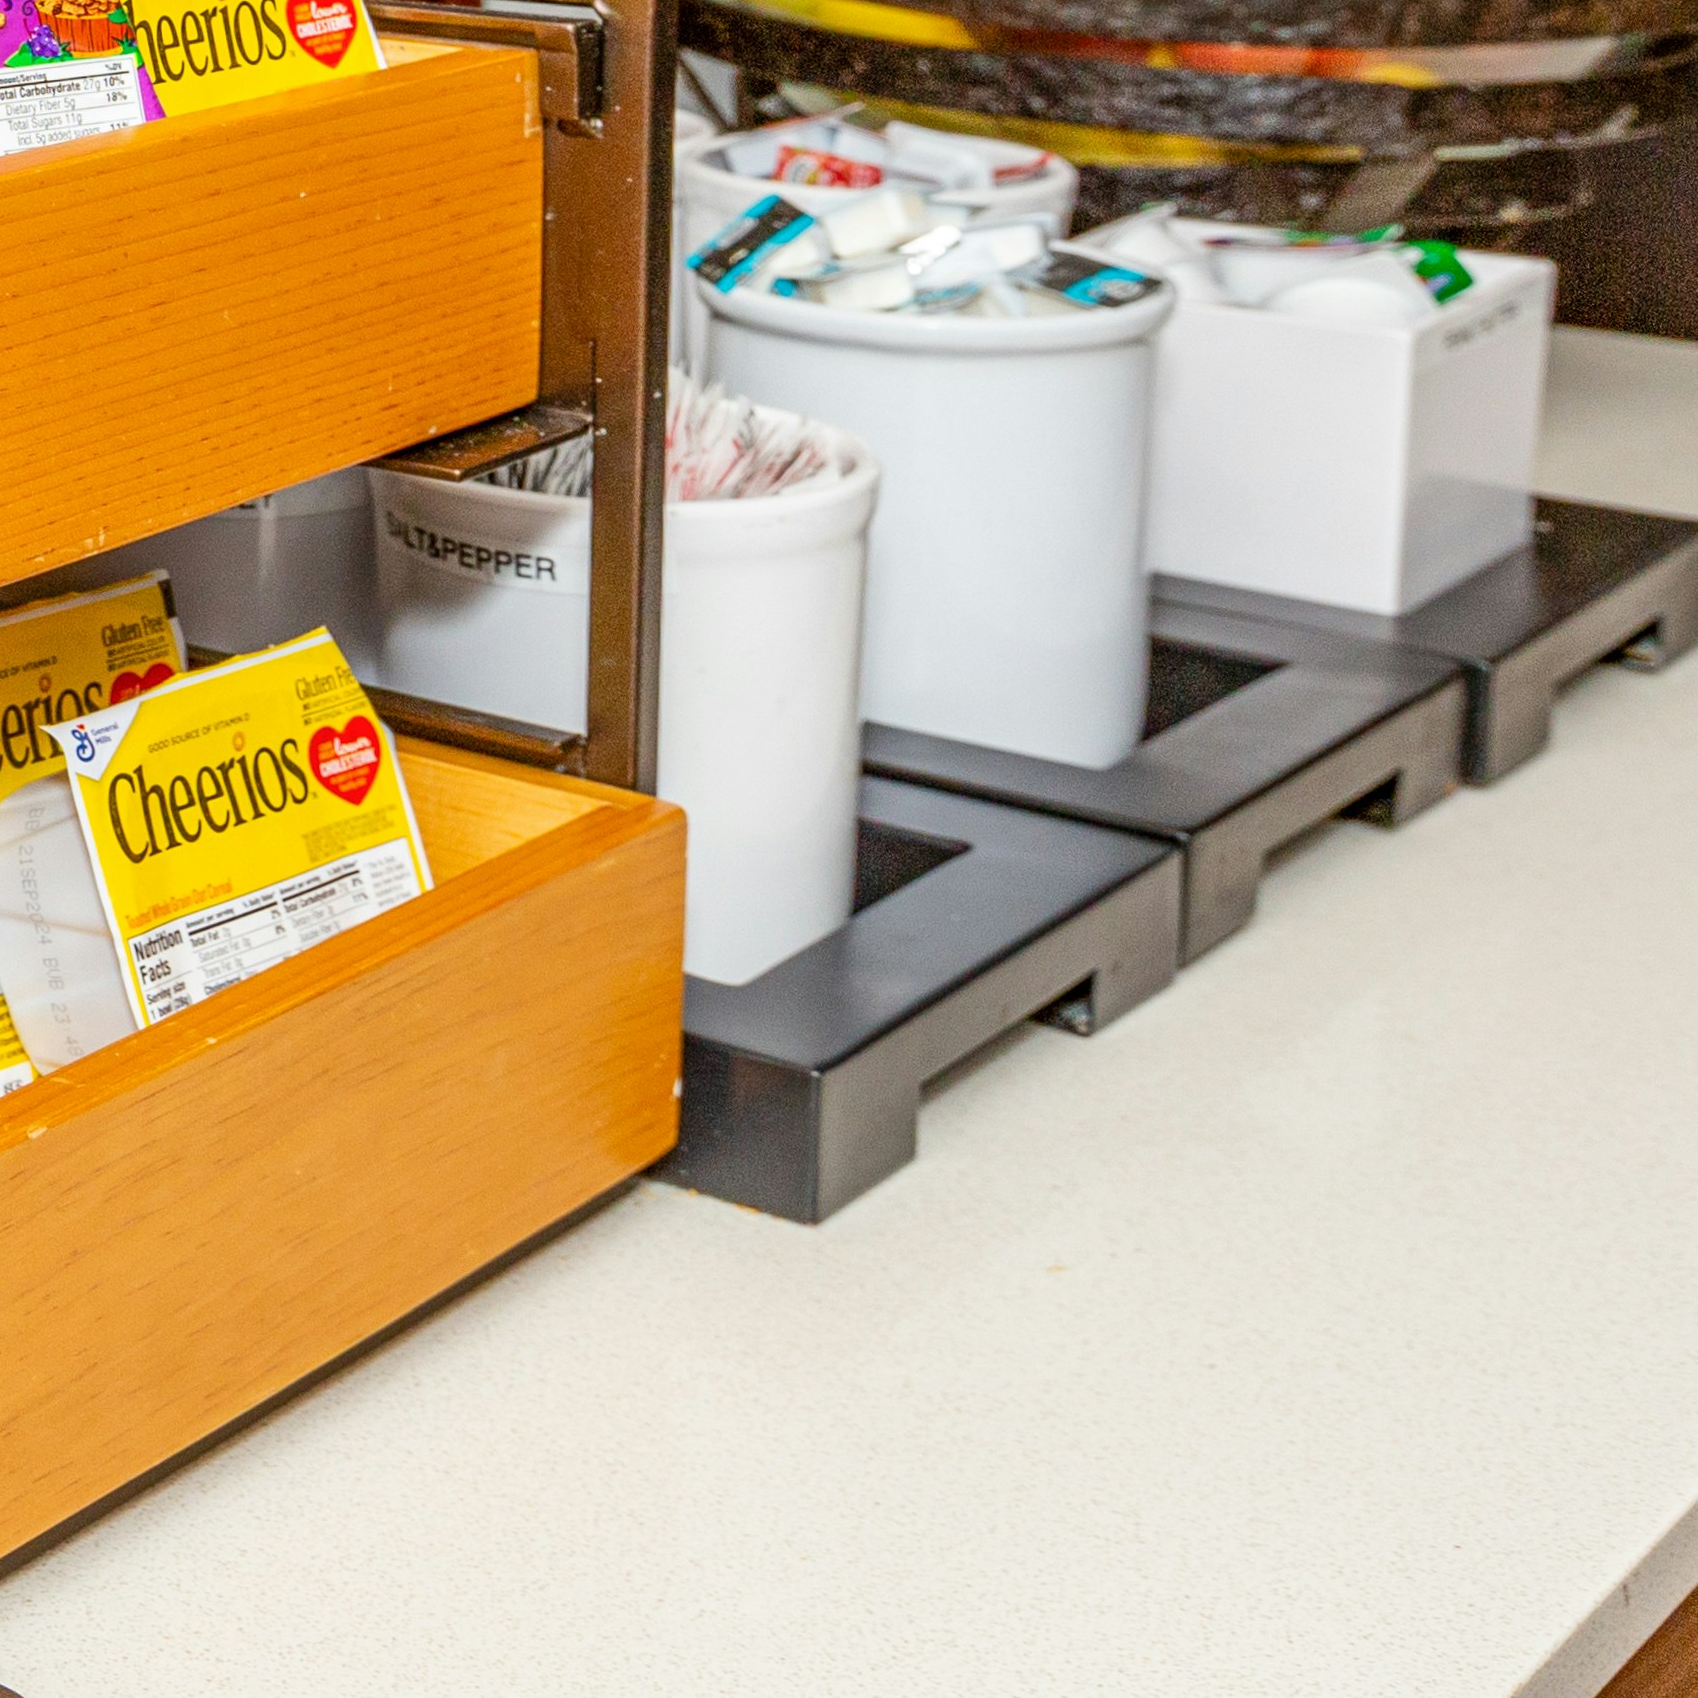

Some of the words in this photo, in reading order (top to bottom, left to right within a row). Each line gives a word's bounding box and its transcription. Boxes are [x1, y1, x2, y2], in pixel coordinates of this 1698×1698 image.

[19, 82, 81, 98] Carbohydrate
[83, 78, 101, 92] 27g
[103, 75, 125, 87] 10%
[5, 102, 37, 117] Dietary
[39, 99, 61, 112] Fiber
[63, 97, 76, 110] 5g
[106, 91, 128, 103] 18%
[7, 119, 29, 132] Total
[31, 115, 63, 131] Sugars
[65, 113, 83, 126] 11g
[294, 674, 337, 701] Gluten
[90, 720, 119, 737] General
[147, 739, 169, 754] GOOD
[169, 731, 199, 749] SOURCE
[201, 725, 213, 739] OF
[214, 717, 243, 735] VITAMIN
[243, 712, 251, 725] D
[107, 738, 310, 865] Cheerios
[133, 928, 184, 963] Nutrition
[139, 959, 172, 986] Facts
